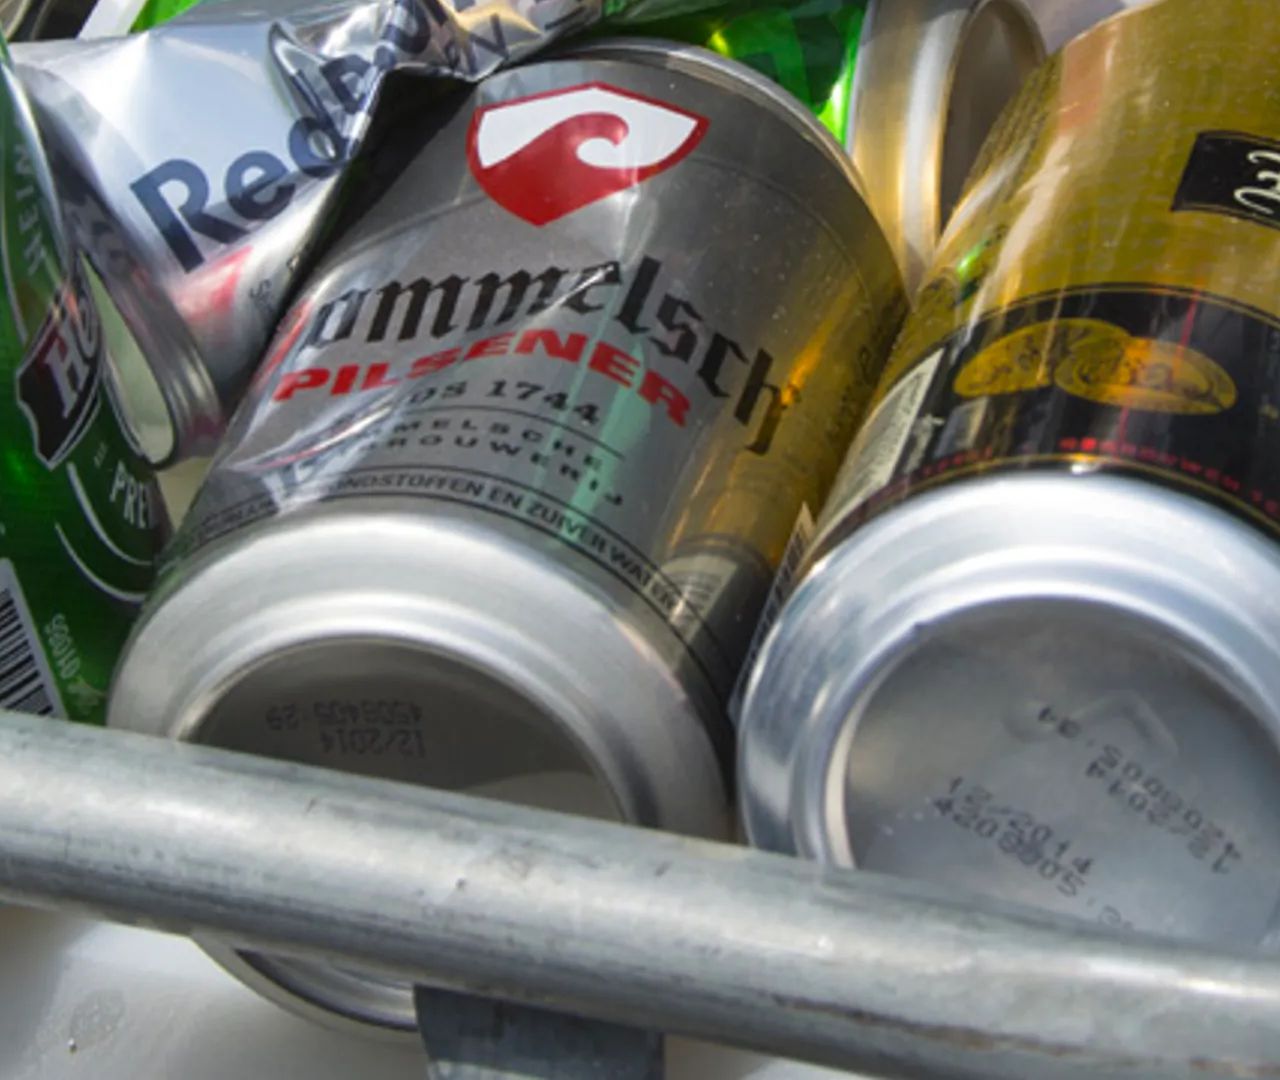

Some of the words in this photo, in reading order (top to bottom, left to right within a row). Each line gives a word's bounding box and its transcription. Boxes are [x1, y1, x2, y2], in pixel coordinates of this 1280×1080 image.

[131, 103, 346, 273] Red
[272, 326, 695, 428] PILSENER
[298, 256, 800, 456] ommelsch
[484, 377, 602, 426] 1744
[380, 430, 626, 506] ROUWERIJ
[488, 484, 524, 511] EN
